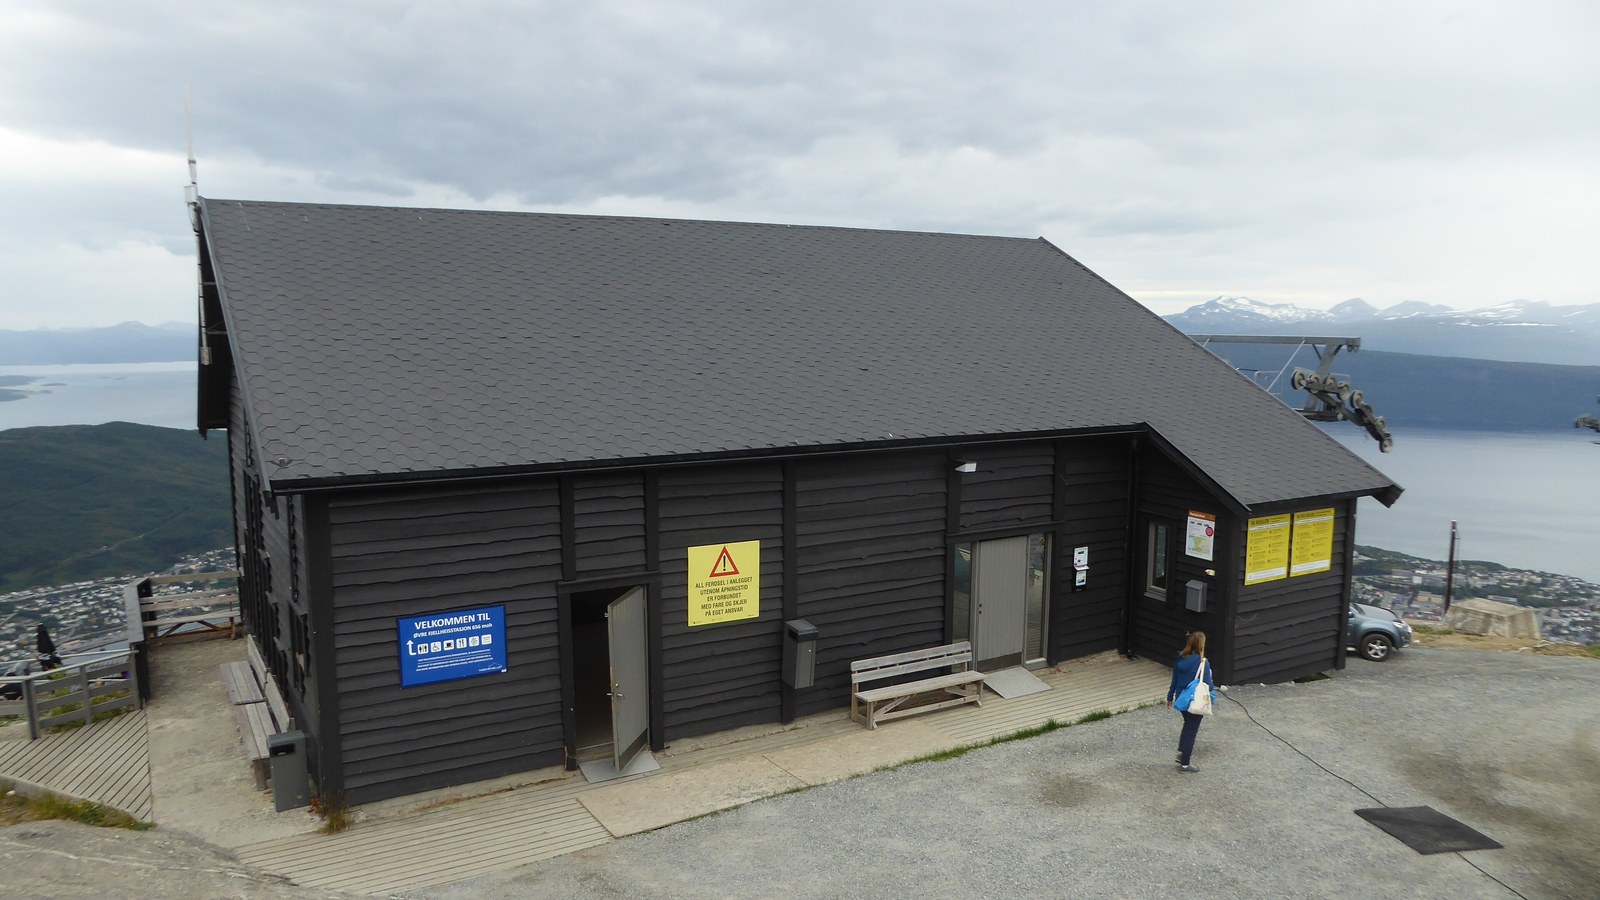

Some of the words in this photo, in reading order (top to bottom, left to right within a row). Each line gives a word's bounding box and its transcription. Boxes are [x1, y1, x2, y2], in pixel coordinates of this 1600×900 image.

[700, 588, 720, 596] UTENOM
[721, 585, 748, 593] ÅPNINGSTID
[714, 593, 741, 601] FORBUNDET
[414, 615, 476, 630] VELKOMMEN
[477, 612, 490, 621] TIL
[413, 631, 428, 639] ØVRE
[428, 626, 471, 636] FJELLHEISSTASJON
